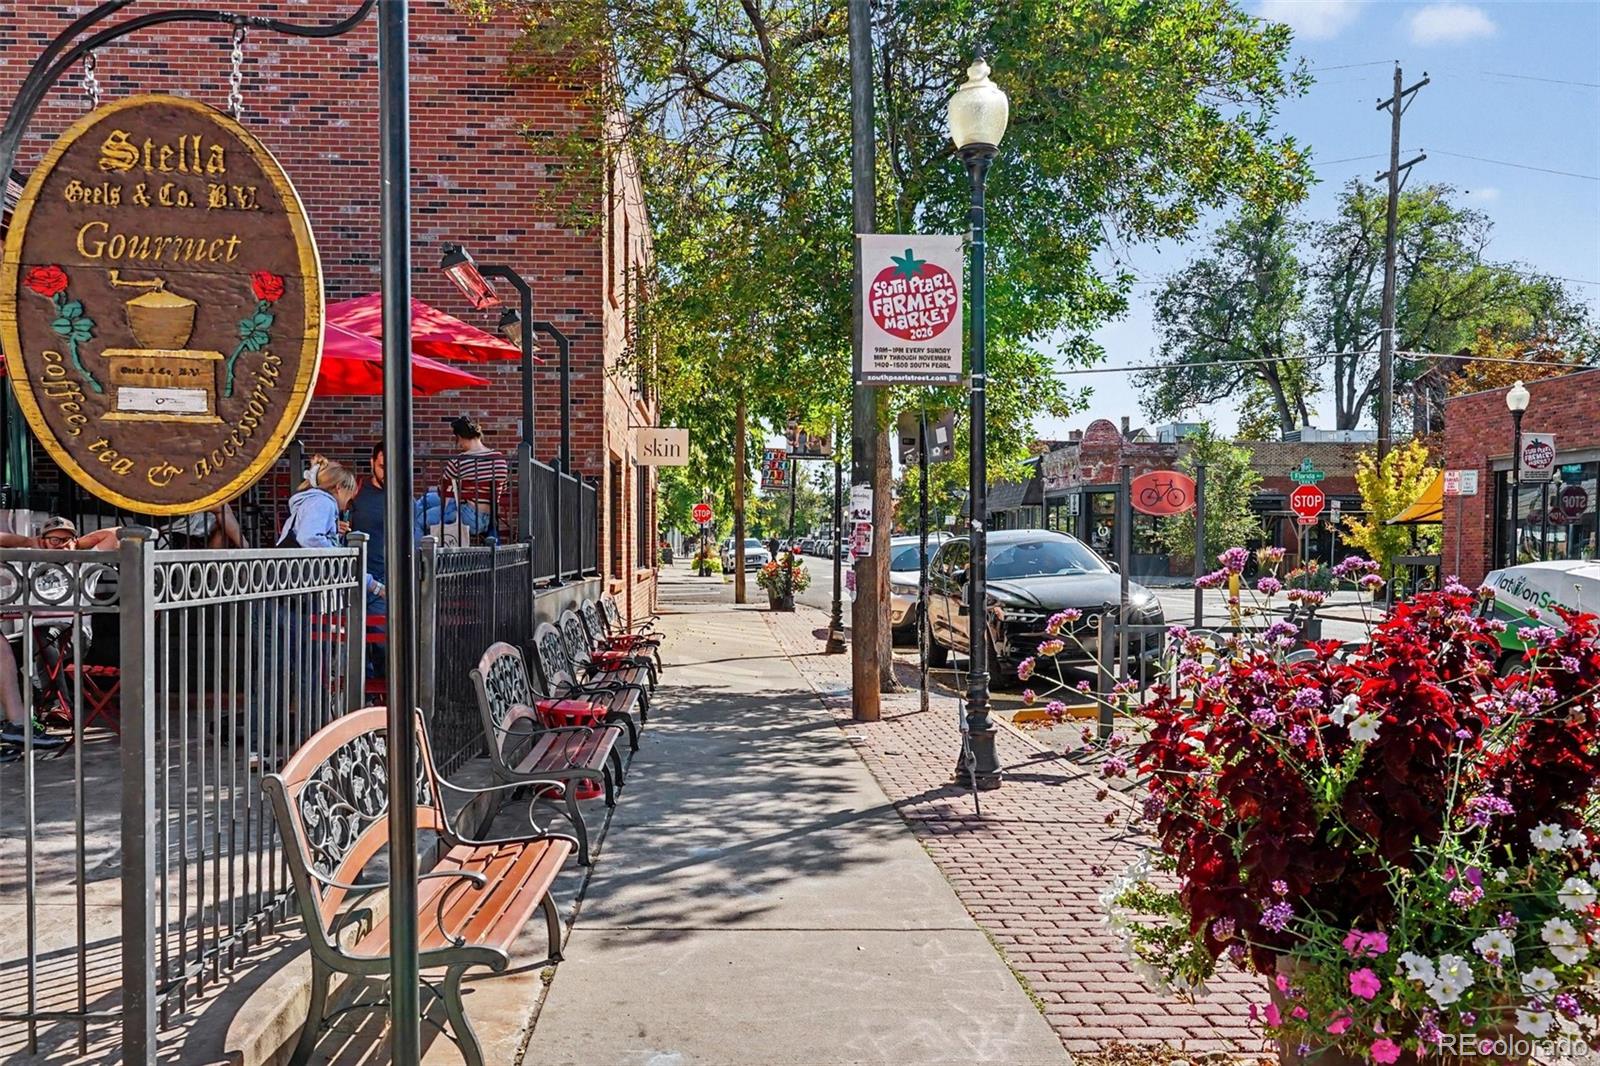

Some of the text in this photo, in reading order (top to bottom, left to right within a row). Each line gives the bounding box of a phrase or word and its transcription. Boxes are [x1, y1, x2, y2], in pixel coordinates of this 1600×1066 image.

[99, 129, 226, 174] Stella
[64, 179, 122, 207] Geels
[132, 182, 151, 207] &
[159, 182, 196, 207] Co.
[76, 221, 241, 262] Gourmet
[931, 362, 952, 370] PEARL
[867, 374, 947, 382] southpearlstreet.com
[41, 350, 88, 437] coffee,
[88, 437, 135, 476] tea
[194, 351, 282, 480] accessories
[643, 437, 681, 457] skin
[1294, 495, 1322, 508] STOP
[694, 509, 711, 518] STOP
